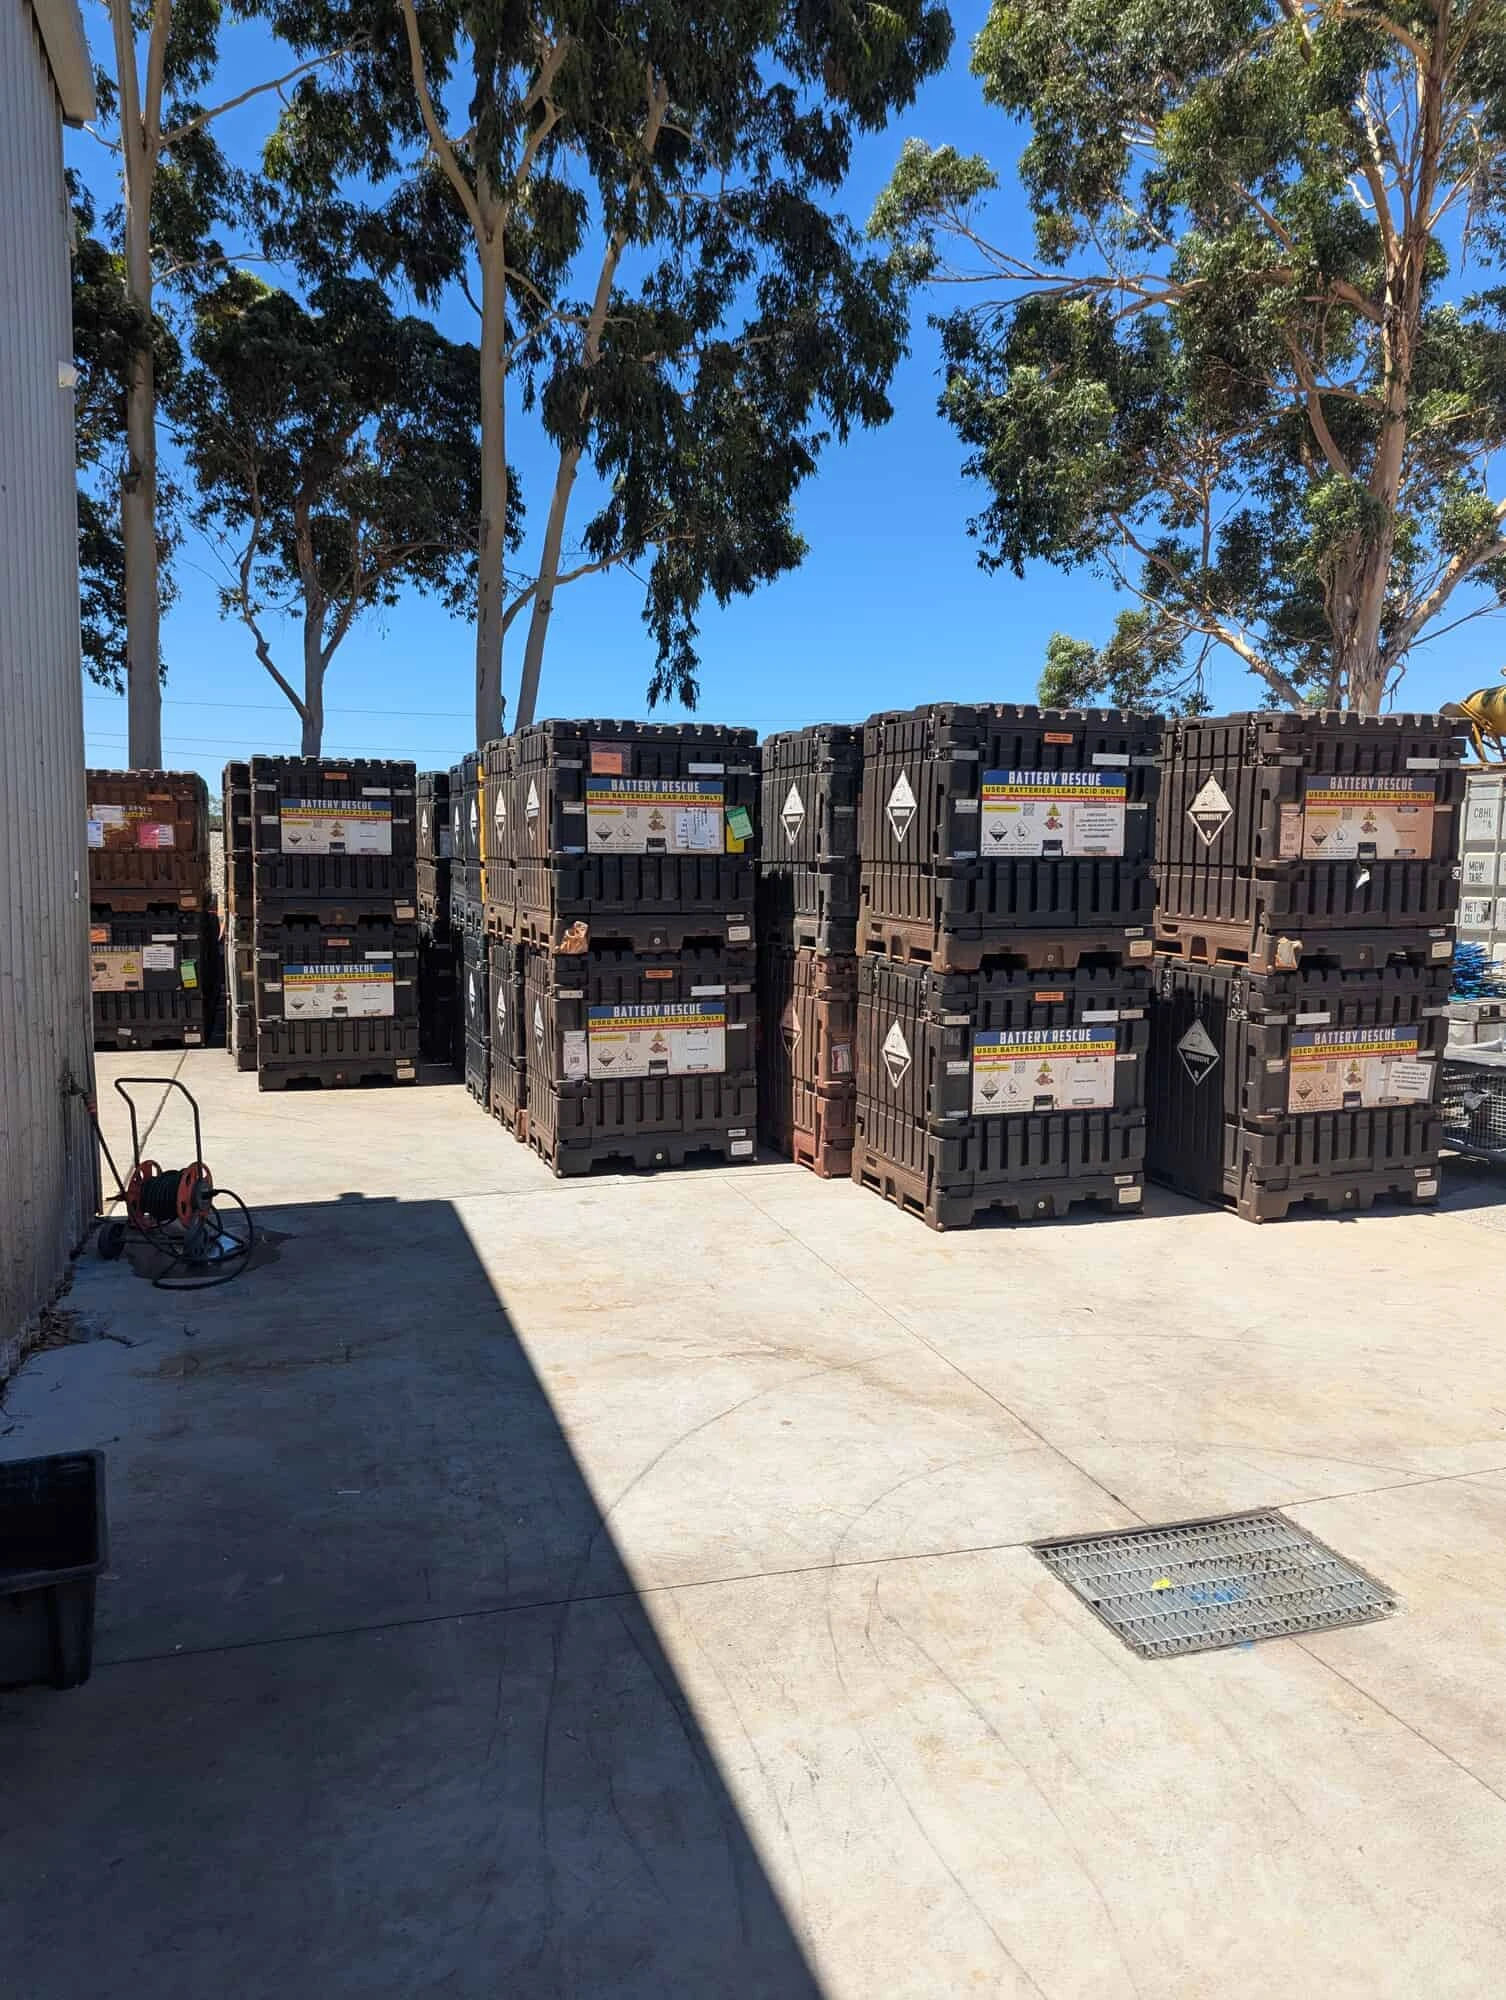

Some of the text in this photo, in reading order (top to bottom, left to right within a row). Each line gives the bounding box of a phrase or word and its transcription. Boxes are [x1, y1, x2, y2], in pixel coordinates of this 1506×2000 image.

[1009, 771, 1102, 786] BATTERY RESCUE
[1330, 776, 1415, 790] BATTERY RESCUE
[611, 779, 701, 793] BATTERY RESCUE
[1468, 861, 1485, 872] MGW
[1468, 872, 1483, 882] TARE
[1464, 902, 1477, 912] NET
[613, 1003, 702, 1017] BATTERY RESCUE
[1000, 1028, 1092, 1044] BATTERY RESCUE
[1315, 1028, 1396, 1044] BATTERY RESCUE
[1000, 1045, 1042, 1053] BATTERIES
